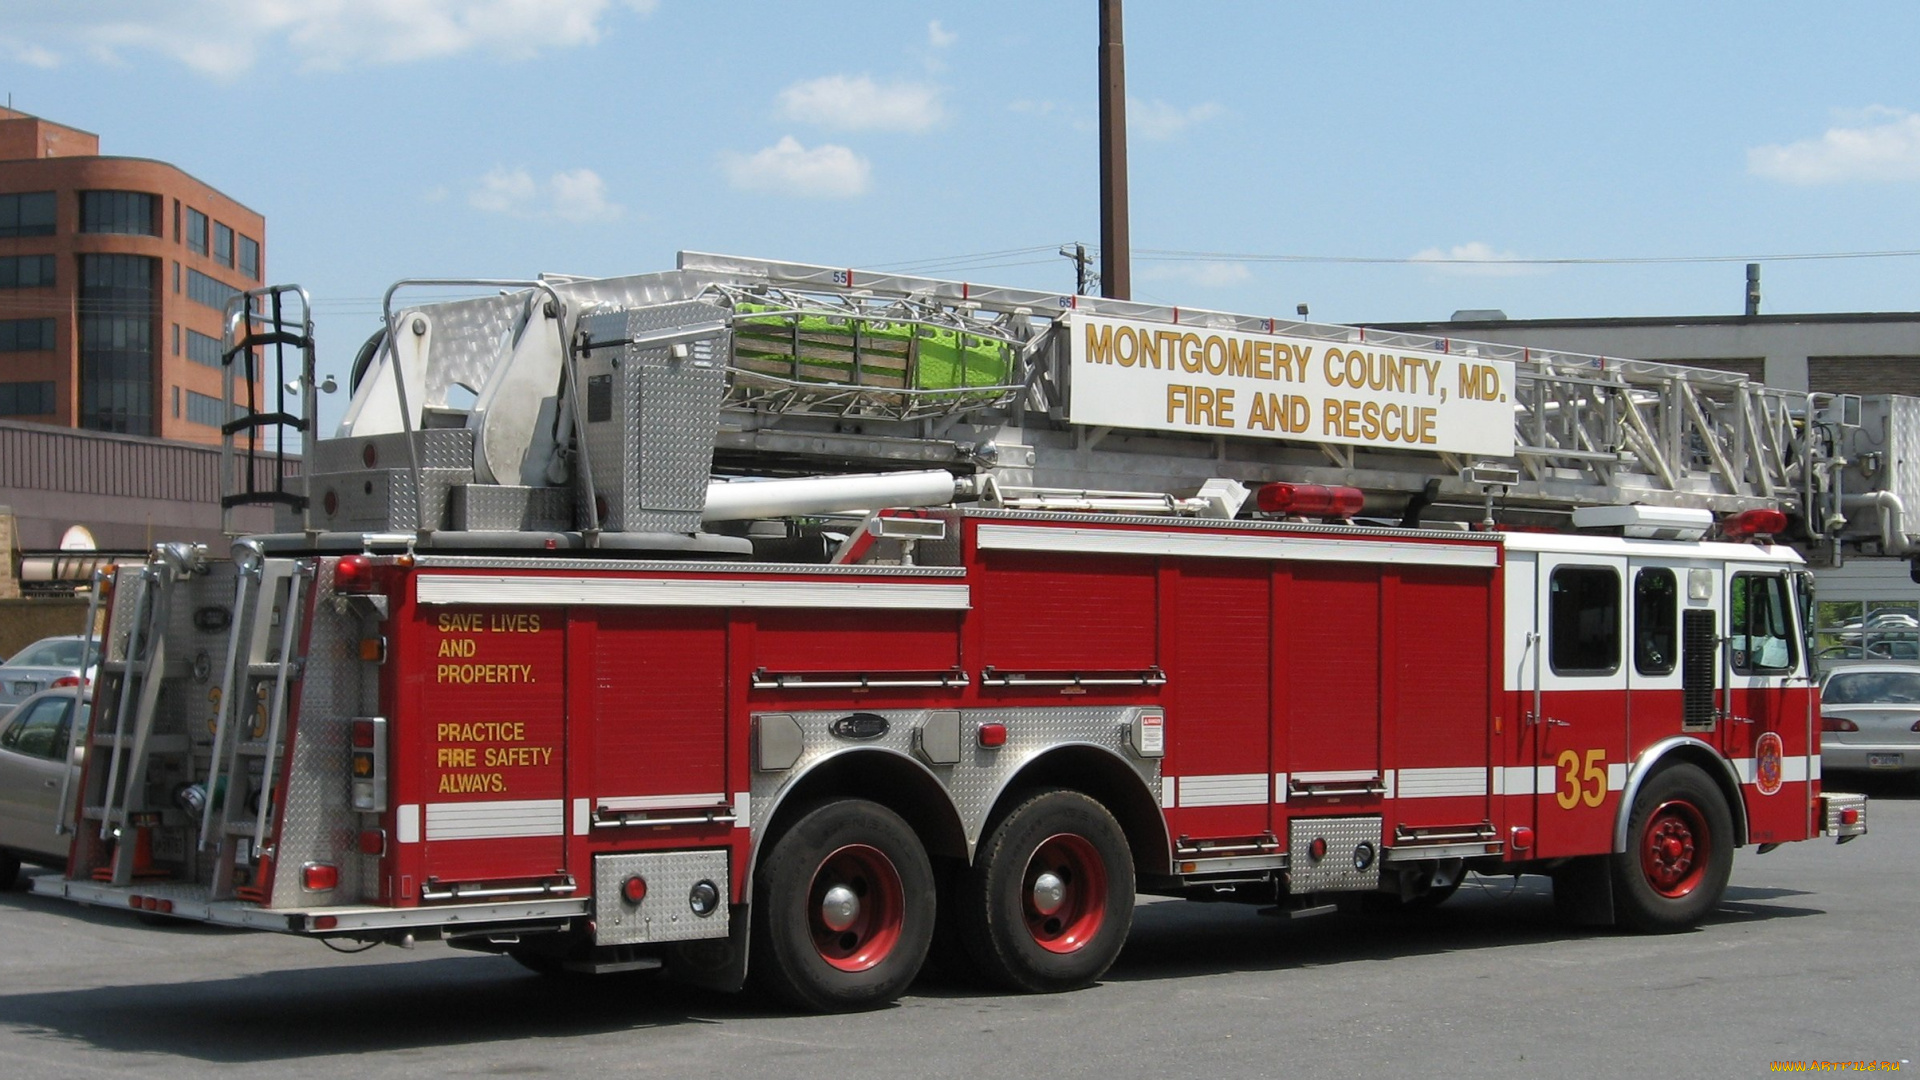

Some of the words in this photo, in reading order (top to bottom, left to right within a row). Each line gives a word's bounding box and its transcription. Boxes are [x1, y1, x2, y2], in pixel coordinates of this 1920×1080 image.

[833, 271, 847, 284] 55
[1059, 296, 1072, 308] 65
[1260, 319, 1271, 331] 75
[1085, 323, 1312, 383] MONTGOMERY
[1323, 346, 1447, 405] COUNTY,
[1458, 358, 1507, 402] MD.
[1167, 384, 1235, 428] FIRE
[1246, 392, 1312, 434] AND
[1323, 398, 1438, 444] RESCUE
[438, 613, 483, 633] SAVE
[491, 613, 541, 633] LIVES
[438, 638, 476, 658] AND
[438, 663, 536, 684] PROPERTY.
[438, 721, 525, 742] PRACTICE
[438, 747, 477, 768] FIRE
[485, 746, 552, 767] SAFETY
[438, 772, 507, 794] ALWAYS.
[1556, 748, 1608, 810] 35
